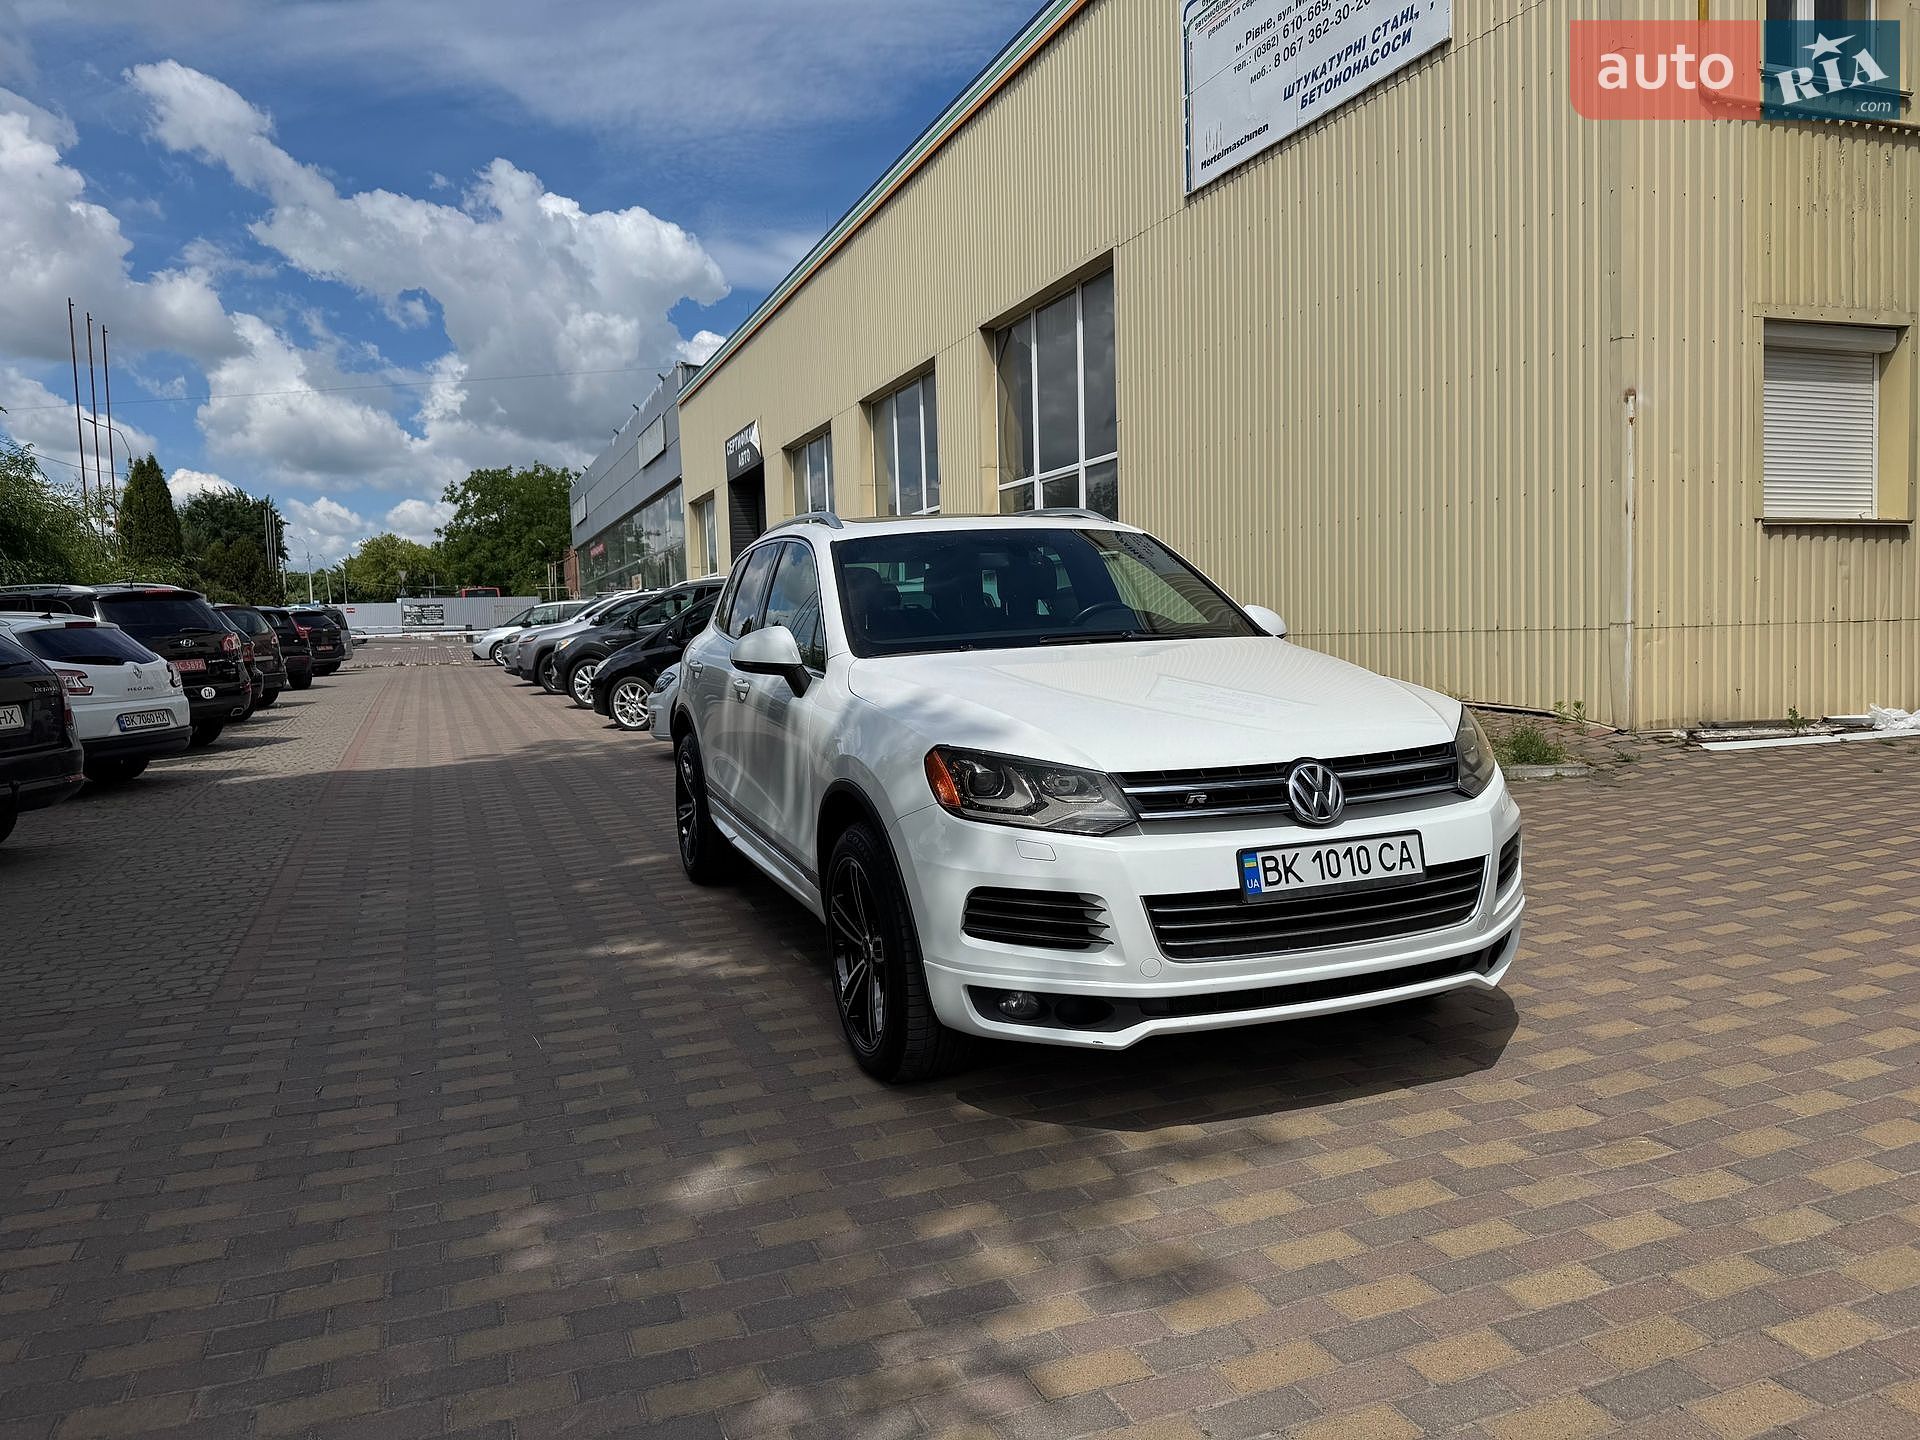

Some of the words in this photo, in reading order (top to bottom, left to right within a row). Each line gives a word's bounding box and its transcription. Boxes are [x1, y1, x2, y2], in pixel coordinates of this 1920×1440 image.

[1207, 13, 1232, 39] ремонт
[1232, 7, 1241, 17] та
[1233, 55, 1252, 74] тел.:
[1254, 34, 1279, 62] (0362)
[1282, 0, 1332, 39] 610-669,
[1235, 42, 1245, 53] м.
[1245, 17, 1276, 46] Рівне,
[1277, 5, 1295, 21] вул.
[1250, 64, 1272, 85] моб.:
[1273, 52, 1281, 68] 8
[1282, 35, 1304, 62] 067
[1283, 34, 1367, 102] ШТУКАТУРНІ
[1300, 26, 1413, 110] БЕТОНОНАСОСИ
[738, 448, 751, 469] АВТО
[203, 689, 213, 697] CH
[124, 714, 138, 727] BK
[137, 713, 155, 725] 7060
[155, 711, 167, 723] HX
[1246, 878, 1260, 890] UA
[1260, 852, 1305, 887] BK
[1311, 844, 1372, 881] 1010
[1378, 840, 1416, 872] CA
